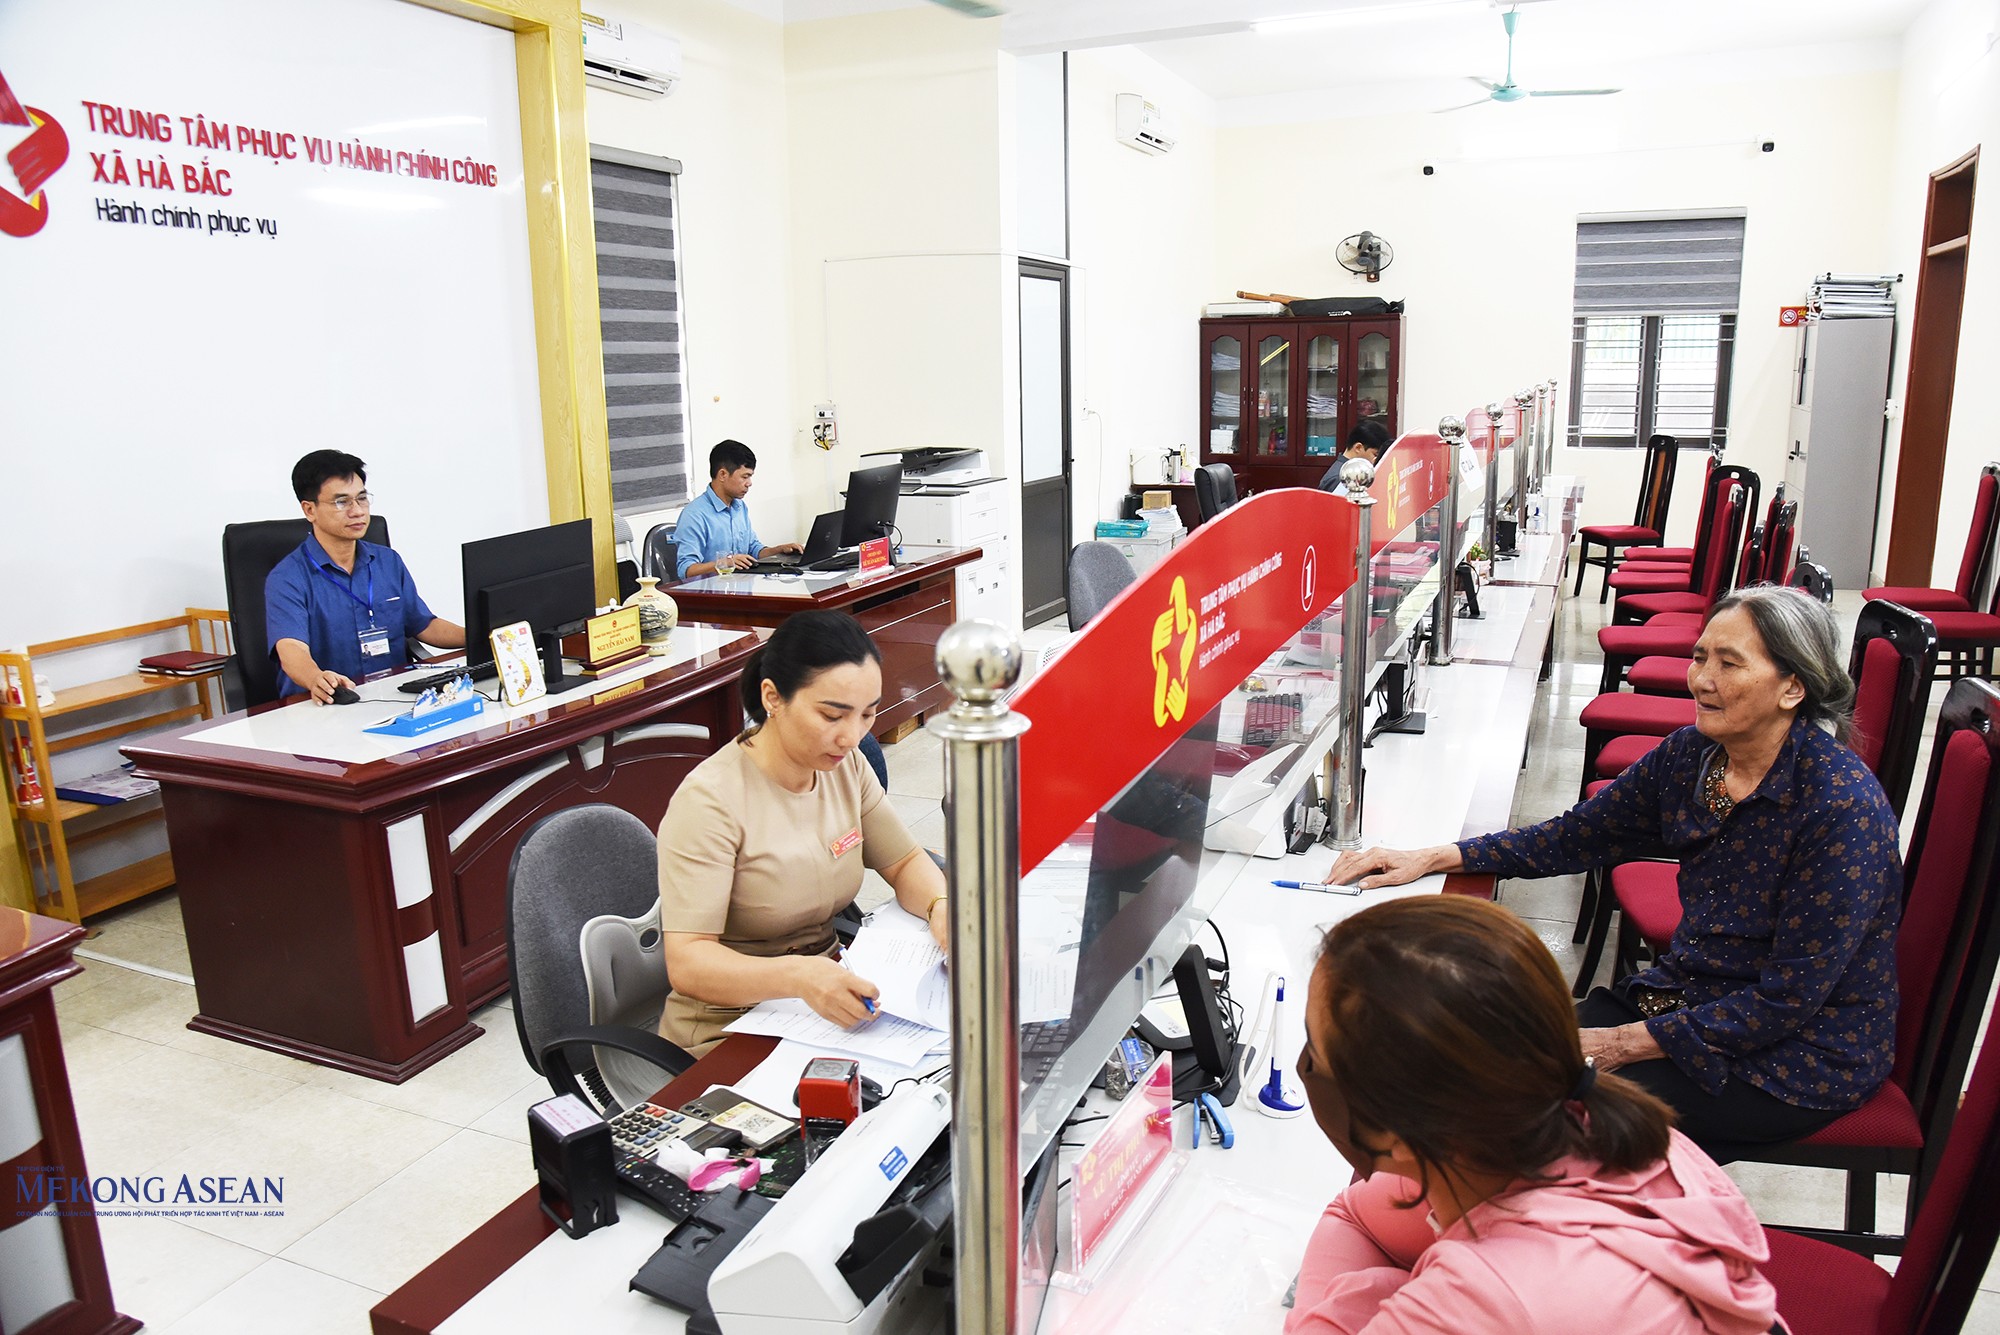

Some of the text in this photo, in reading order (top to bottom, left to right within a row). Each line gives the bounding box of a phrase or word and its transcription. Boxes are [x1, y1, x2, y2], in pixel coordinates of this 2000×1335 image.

[82, 100, 498, 187] TRUNG TÂM PHỤC VỤ HÀNH CHÍNH CÔNG
[90, 149, 232, 197] XÃ HÀ BẮC
[95, 197, 277, 240] Hành chính phục vụ
[1200, 590, 1218, 616] TRUNG
[1218, 583, 1228, 605] TÂM
[1227, 576, 1241, 599] PHỤC
[1247, 566, 1259, 588] HÀNH
[1259, 557, 1272, 579] CHÍNH
[1271, 551, 1283, 572] CÔNG
[1304, 559, 1313, 600] 1
[1199, 620, 1207, 645] XÃ
[1207, 616, 1215, 639] HÀ
